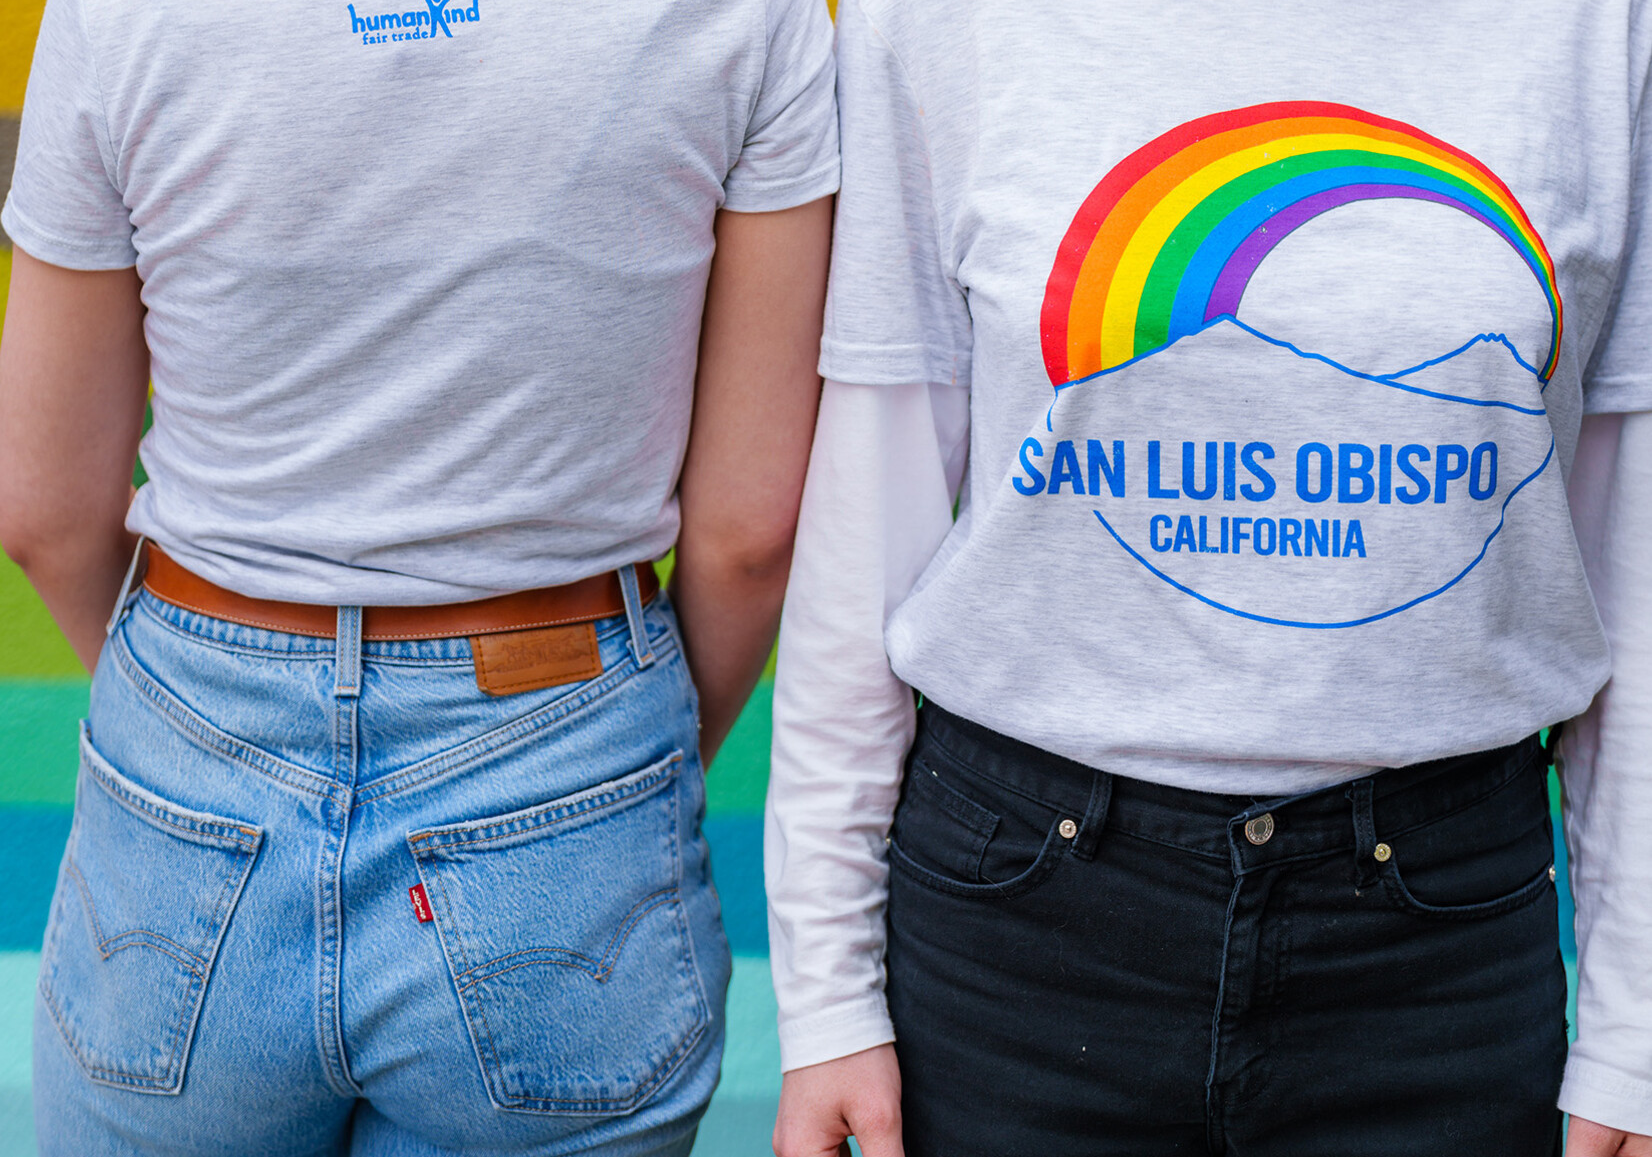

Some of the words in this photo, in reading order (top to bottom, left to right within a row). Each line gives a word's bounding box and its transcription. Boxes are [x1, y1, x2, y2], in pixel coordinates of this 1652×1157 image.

[362, 32, 388, 45] fair
[392, 26, 429, 42] trade
[1011, 436, 1126, 500] SAN
[1147, 439, 1277, 503] LUIS
[1295, 441, 1499, 505] OBISPO
[1149, 513, 1367, 559] CALIFORNIA
